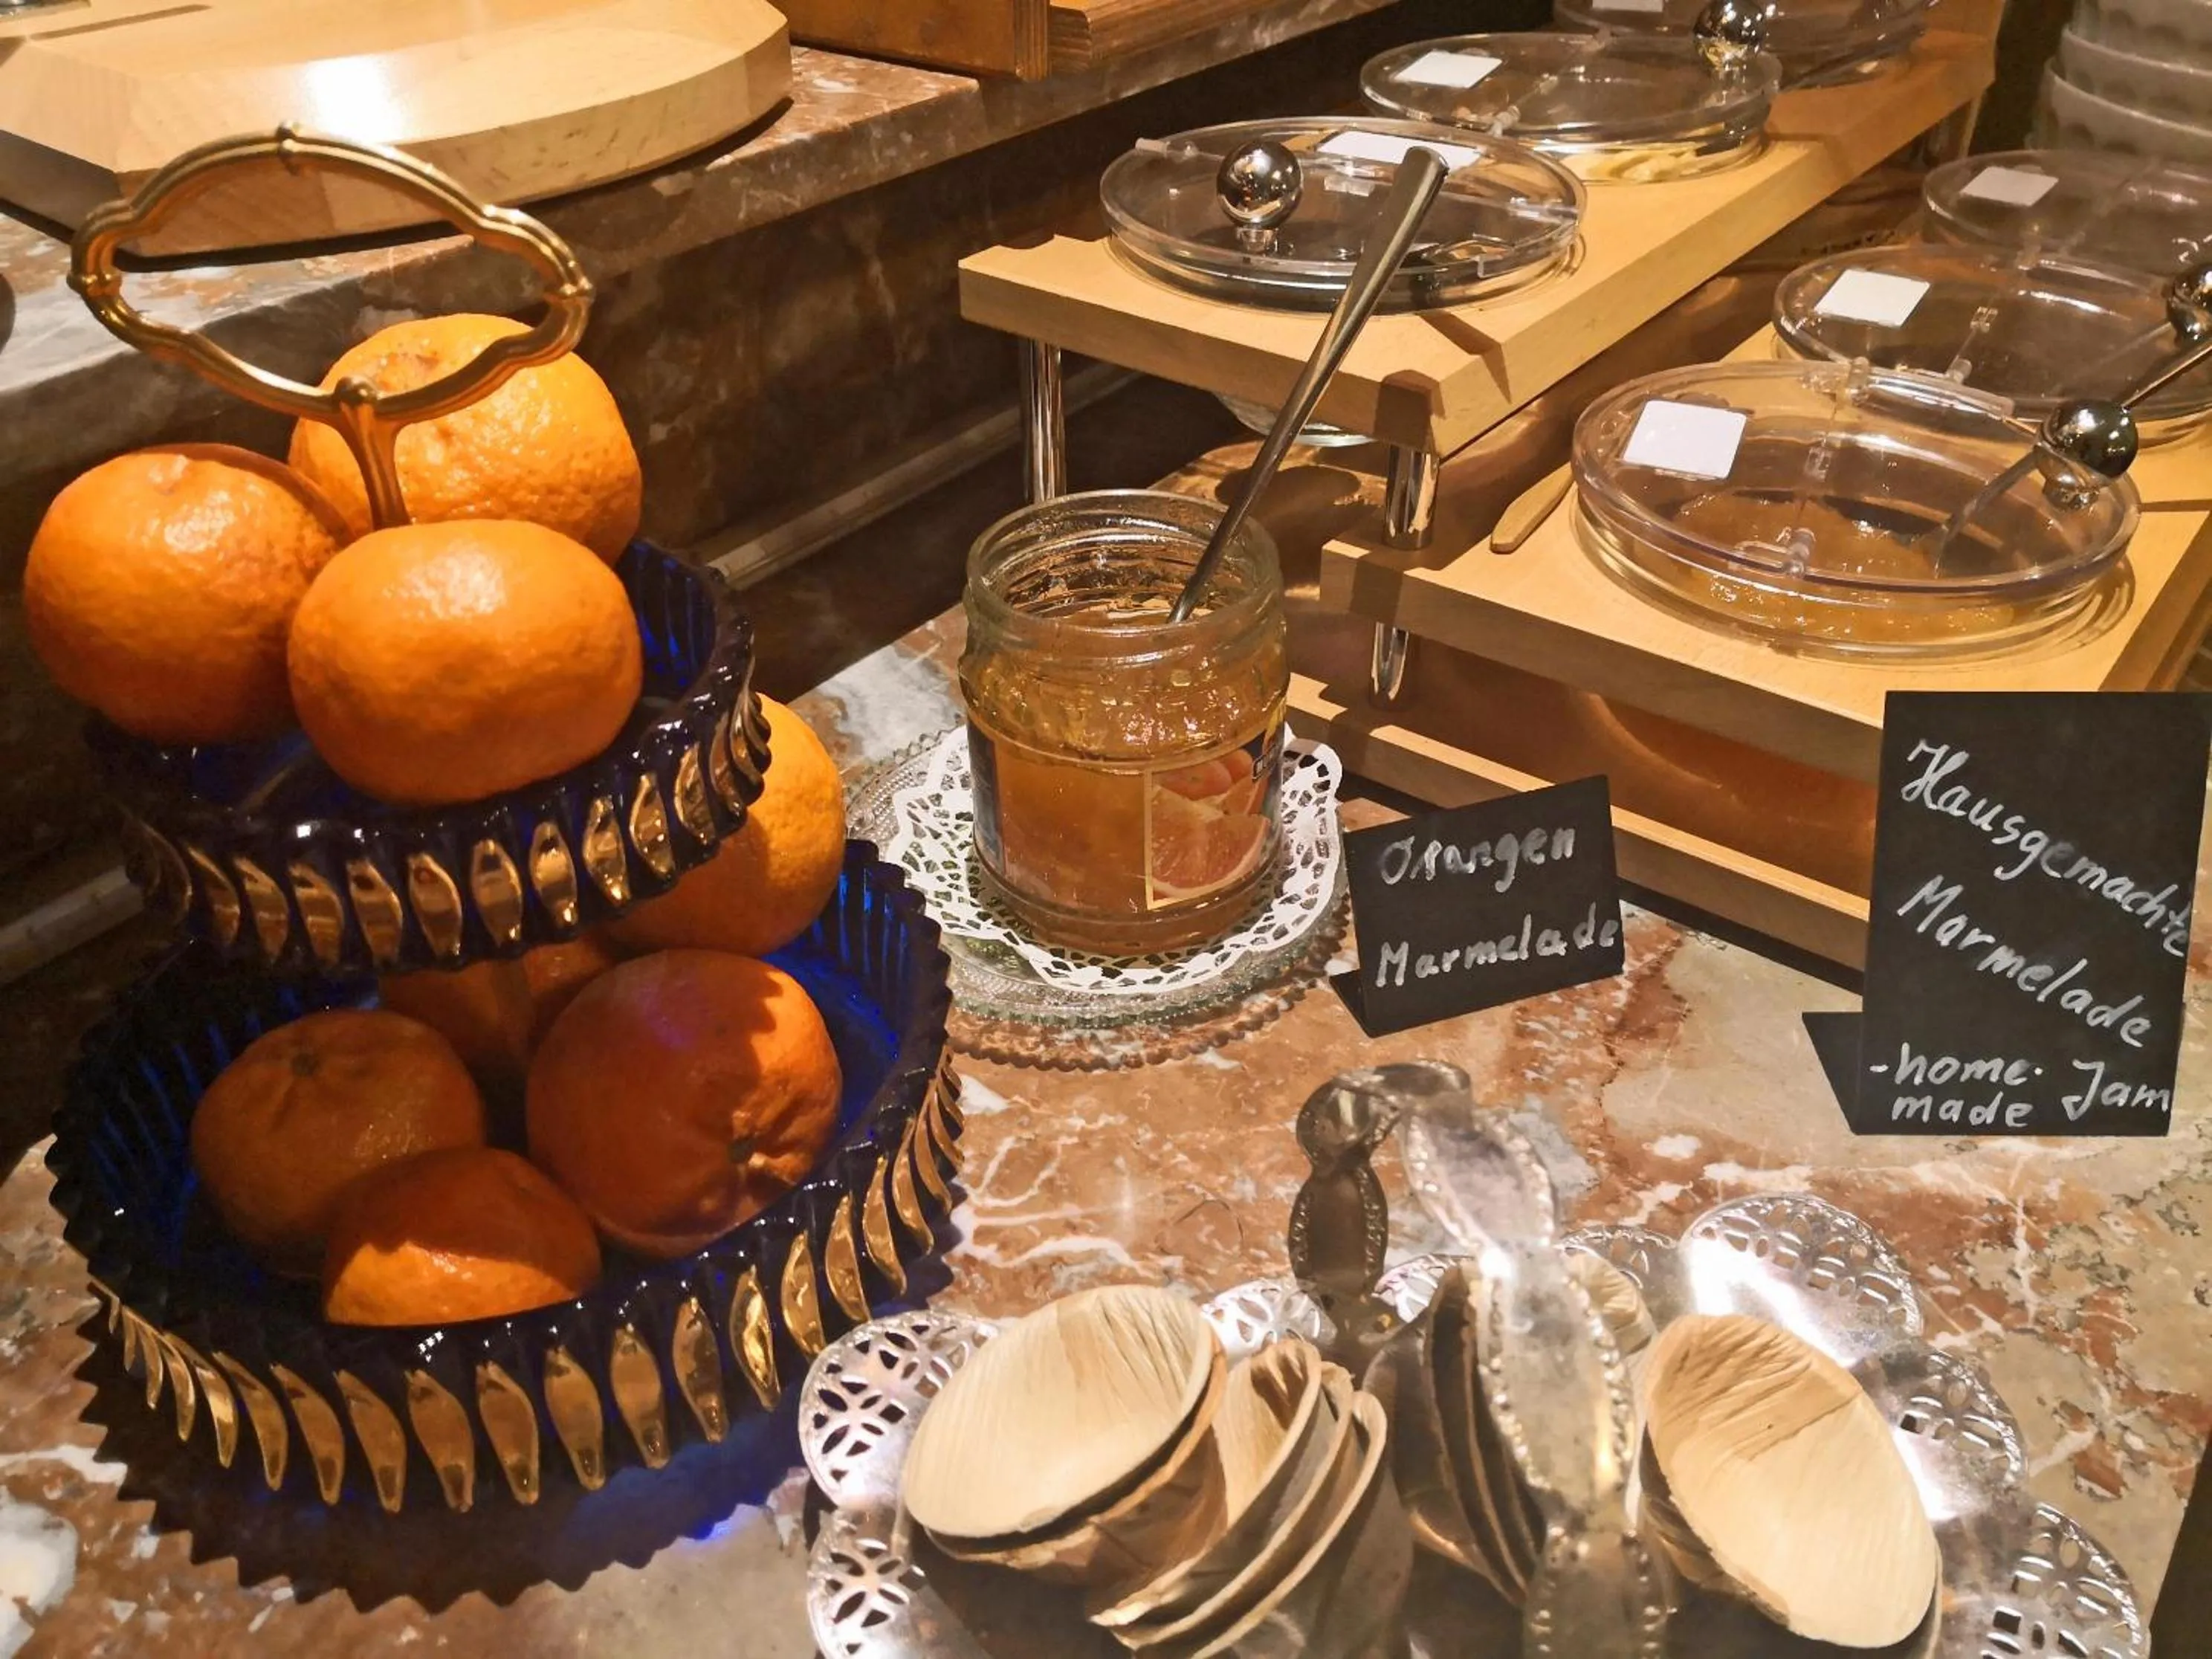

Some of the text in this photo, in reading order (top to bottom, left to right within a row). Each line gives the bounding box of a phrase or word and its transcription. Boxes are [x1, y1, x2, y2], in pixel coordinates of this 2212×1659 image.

[1380, 827, 1576, 893] Orangen
[1901, 739, 2190, 957] Hausgemachte
[1376, 902, 1619, 987] Marmelade
[1898, 874, 2152, 1047] Marmelade
[1892, 1058, 2170, 1128] made Jam
